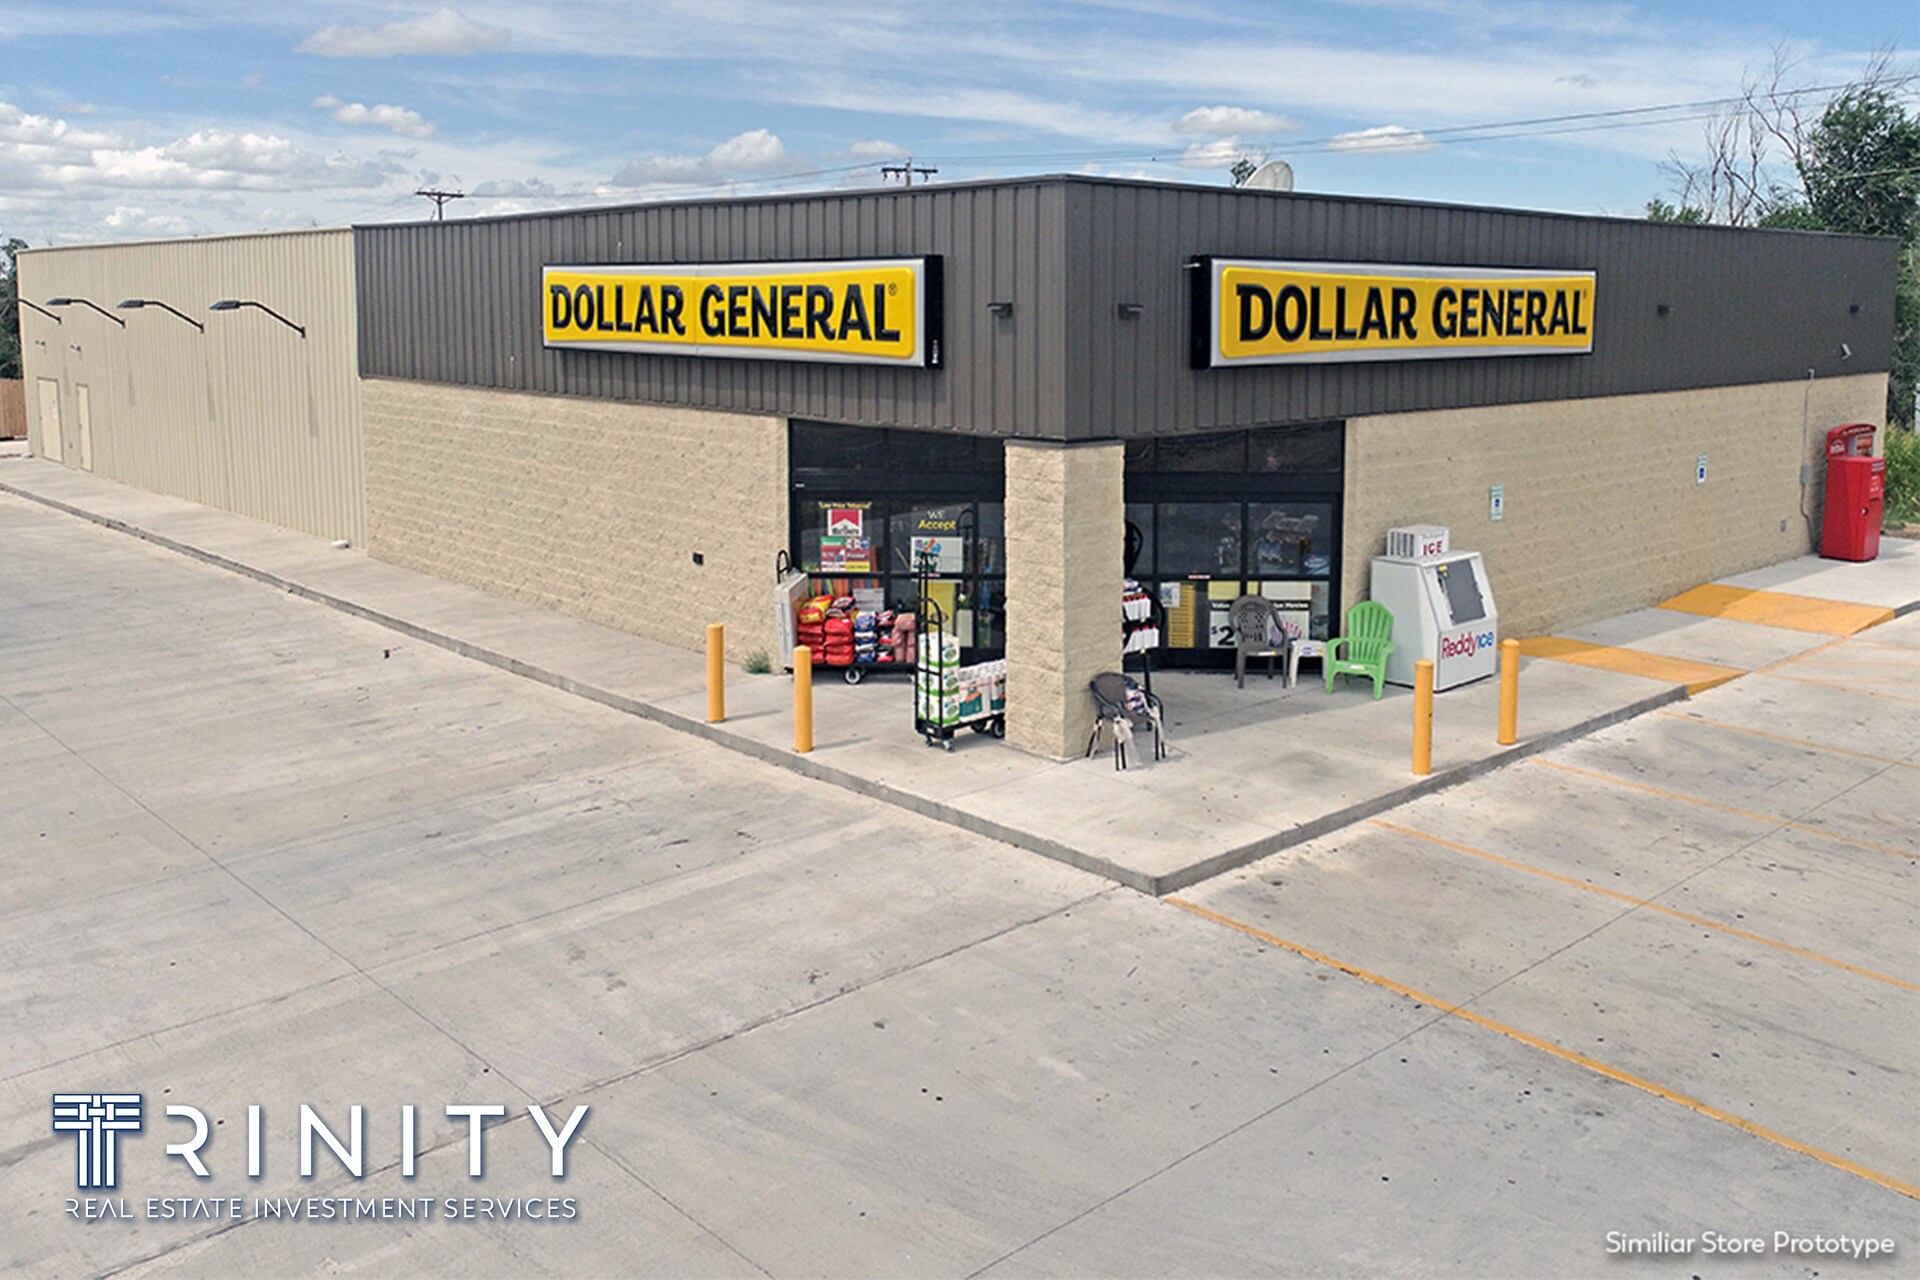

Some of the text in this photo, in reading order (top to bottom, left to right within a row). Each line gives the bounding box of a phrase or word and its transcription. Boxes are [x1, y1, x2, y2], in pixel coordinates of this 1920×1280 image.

[550, 283, 901, 342] DOLLAR GENERAL
[1236, 283, 1587, 343] DOLLAR GENERAL
[918, 519, 956, 531] Accept
[1423, 541, 1443, 556] ICE
